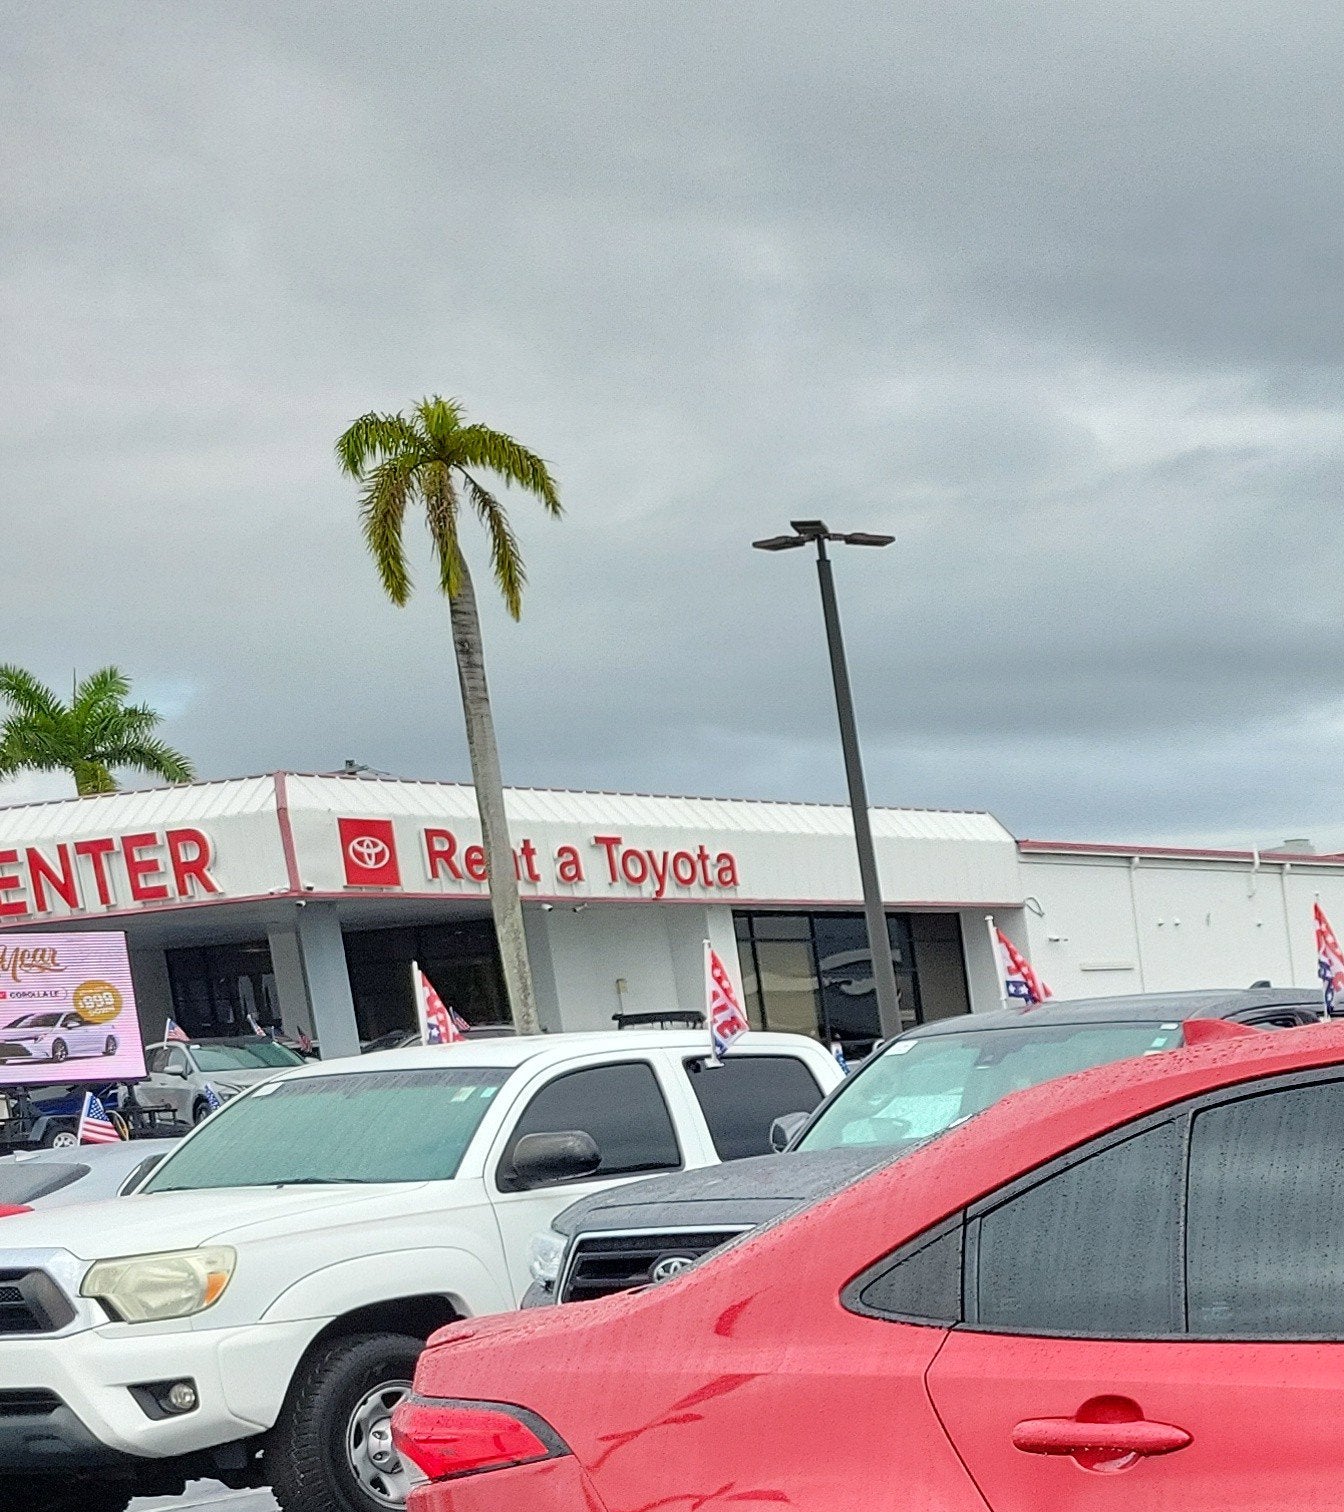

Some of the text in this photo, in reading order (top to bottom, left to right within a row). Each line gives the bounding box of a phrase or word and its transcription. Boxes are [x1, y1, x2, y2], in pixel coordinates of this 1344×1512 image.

[0, 828, 218, 916] ENTER
[424, 828, 739, 899] Ret a Toyota
